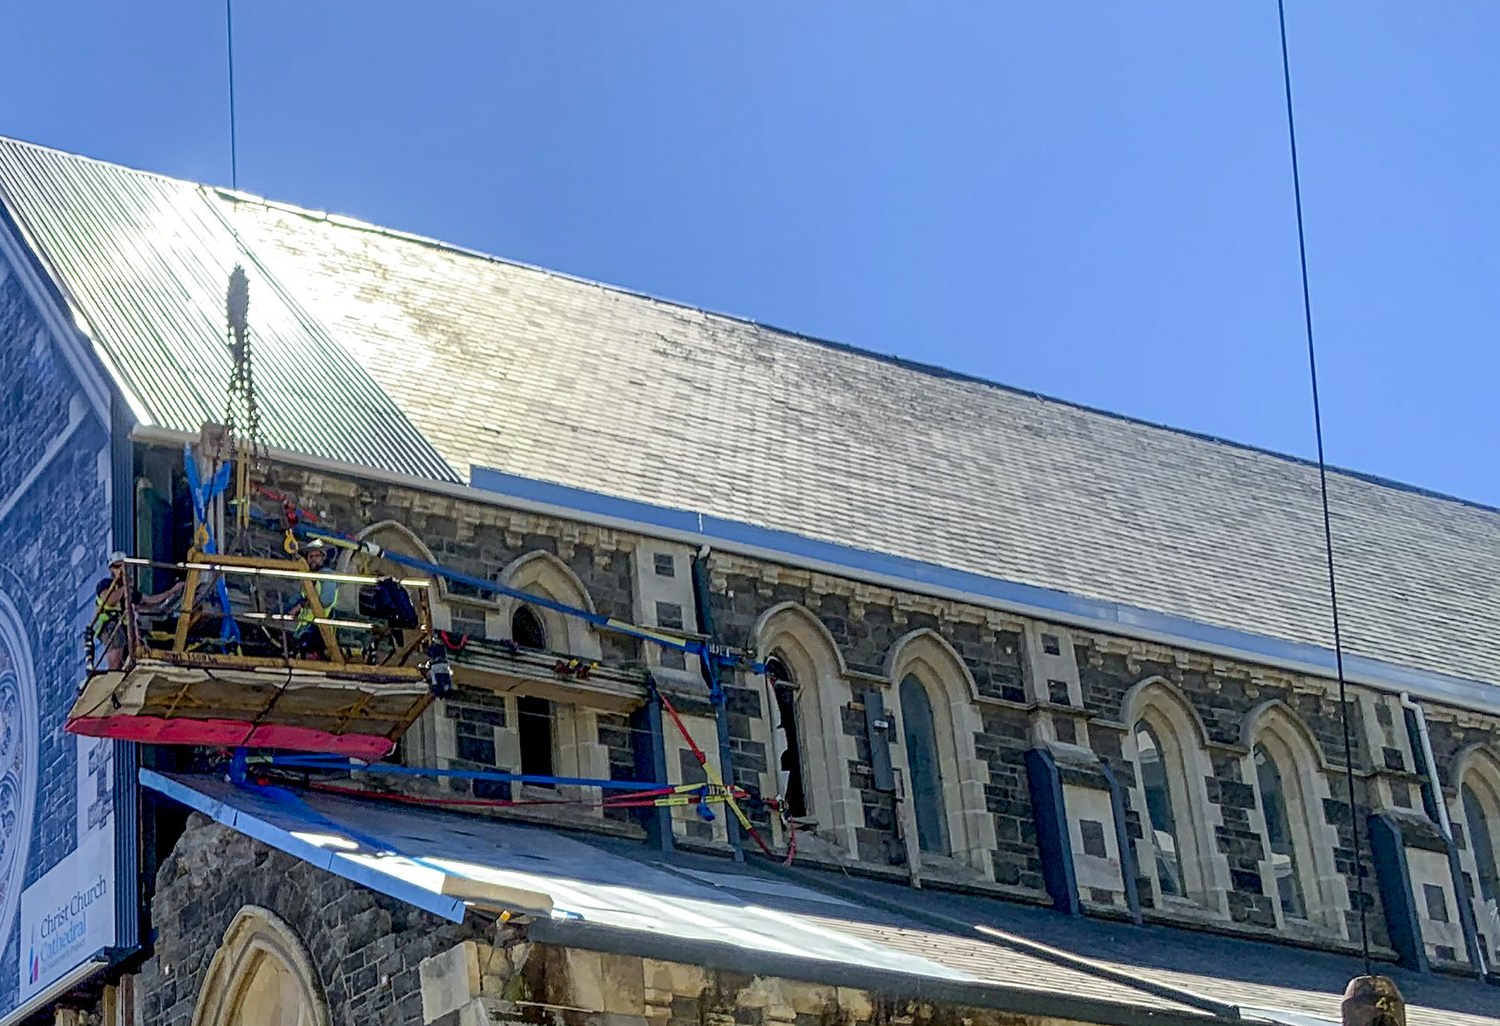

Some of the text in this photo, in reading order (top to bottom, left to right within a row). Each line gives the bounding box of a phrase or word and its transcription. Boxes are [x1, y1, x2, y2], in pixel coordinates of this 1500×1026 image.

[41, 874, 107, 938] Christ Church
[40, 911, 86, 972] Cathedral
